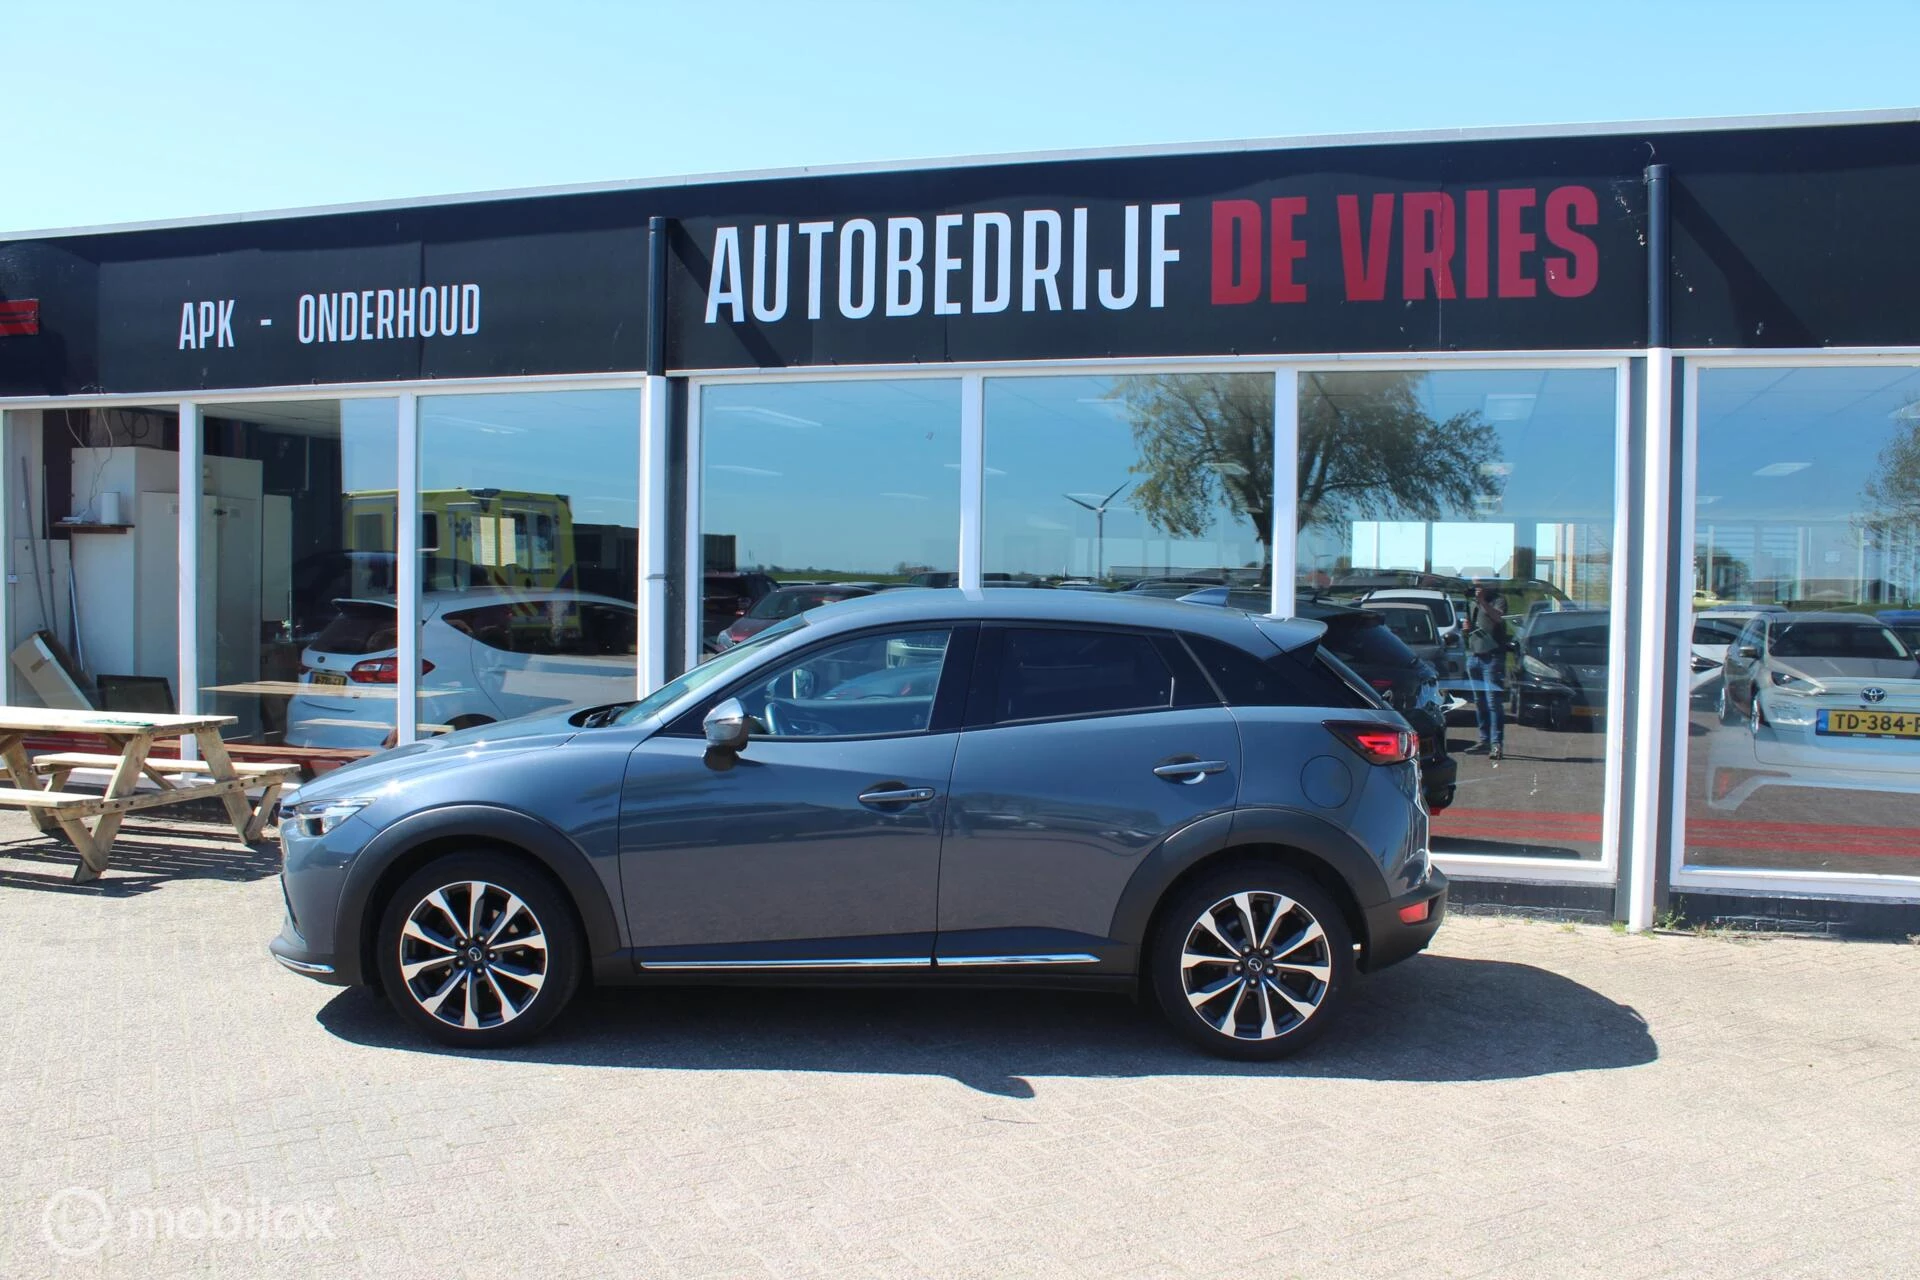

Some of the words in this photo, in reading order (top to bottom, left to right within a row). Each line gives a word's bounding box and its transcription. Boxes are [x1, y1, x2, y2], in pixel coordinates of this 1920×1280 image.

[704, 203, 1181, 324] AUTOBEDRIJF
[1211, 197, 1307, 305] DE
[1336, 185, 1599, 302] VRIES
[178, 299, 236, 350] APK
[298, 283, 480, 344] ONDERHOUD
